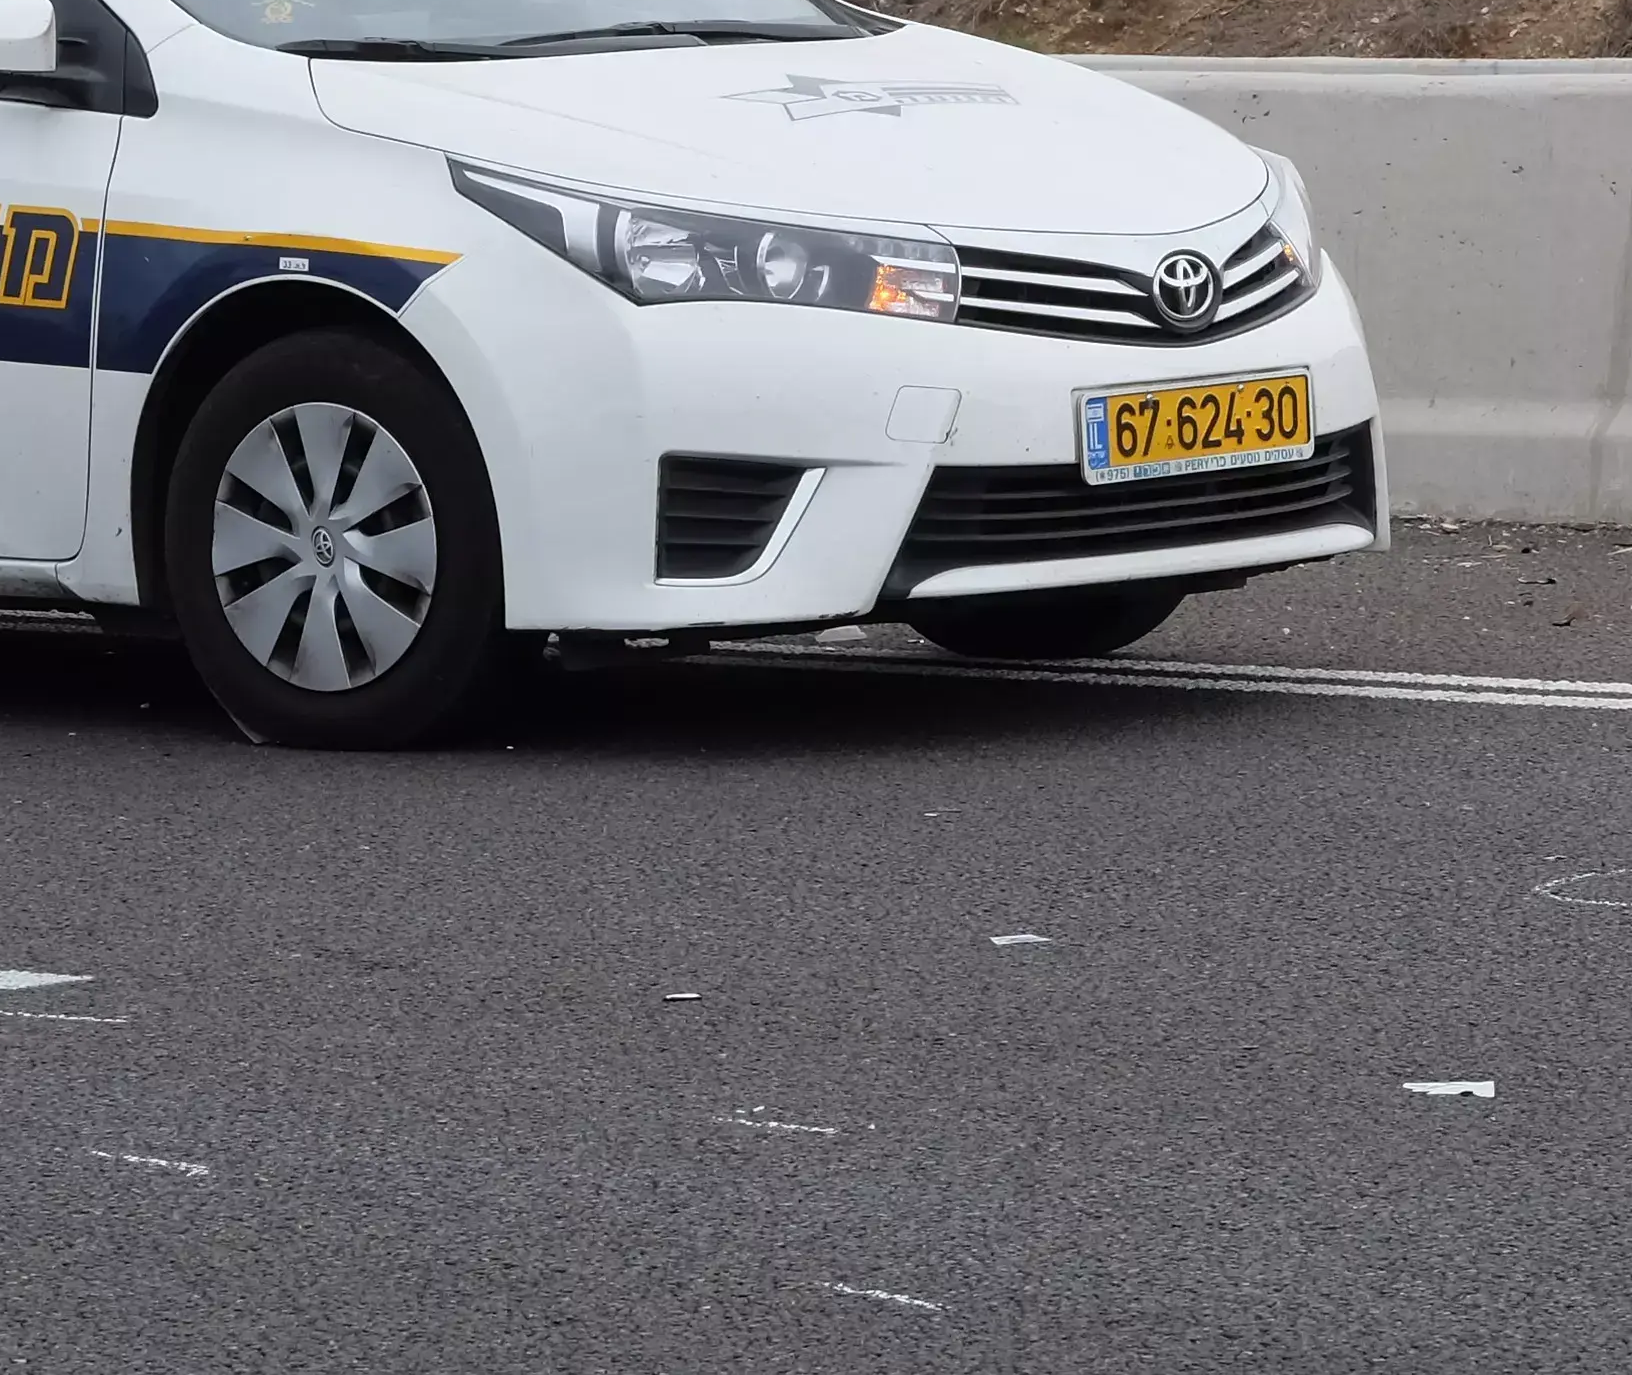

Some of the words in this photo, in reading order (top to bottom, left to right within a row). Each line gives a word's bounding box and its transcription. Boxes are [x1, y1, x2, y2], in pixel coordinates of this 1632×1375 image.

[1087, 422, 1103, 450] IL
[1230, 451, 1260, 466] נוסעים
[1264, 448, 1294, 462] עסקים
[1184, 458, 1209, 471] PERY
